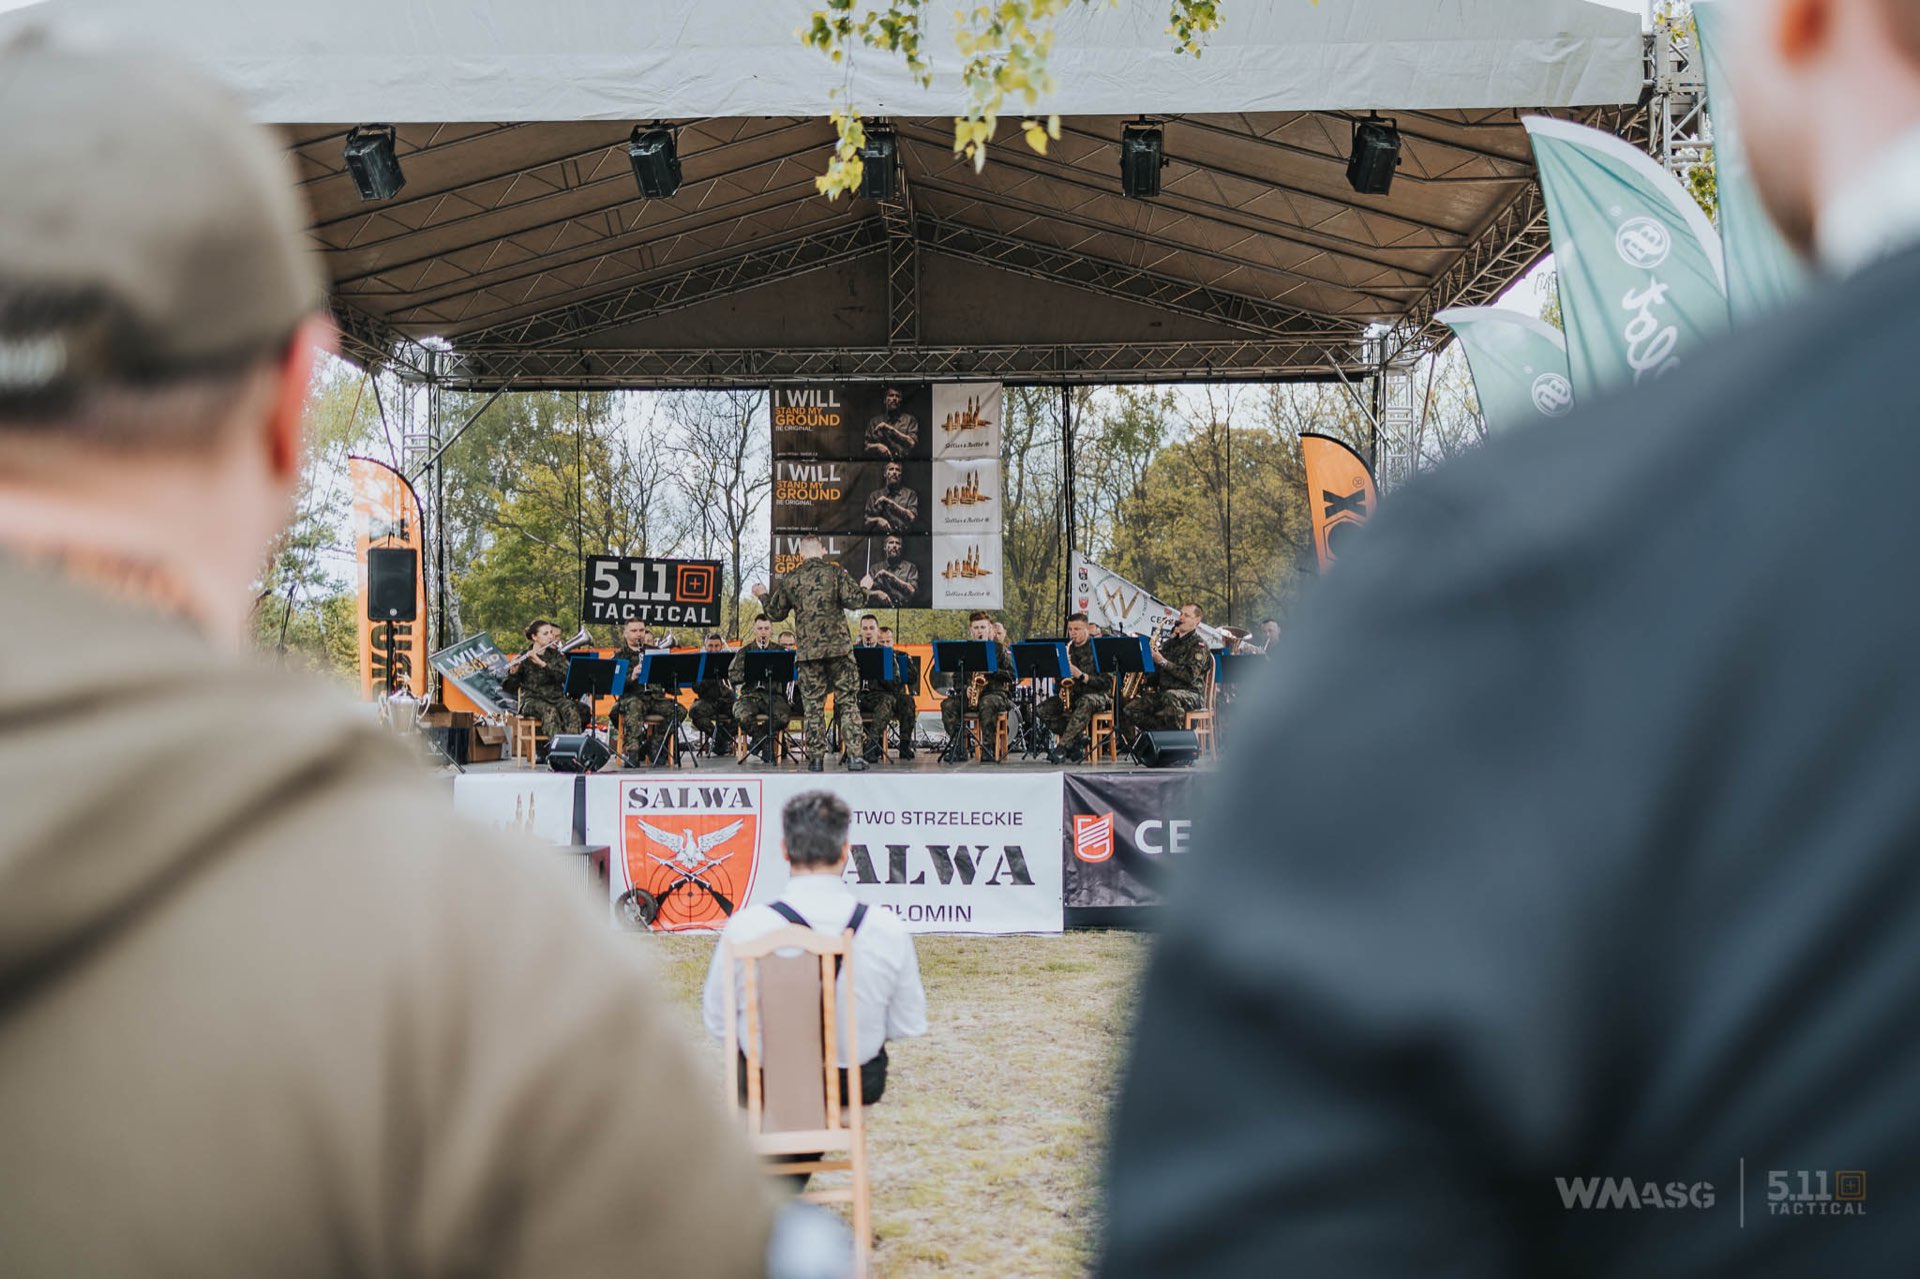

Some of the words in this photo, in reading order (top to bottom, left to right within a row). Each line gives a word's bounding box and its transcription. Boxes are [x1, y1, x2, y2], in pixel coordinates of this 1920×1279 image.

[774, 389, 780, 407] I
[786, 389, 841, 408] WILL
[775, 407, 806, 415] STAND
[808, 407, 823, 415] MY
[775, 414, 841, 426] GROUND
[776, 463, 782, 480] I
[788, 463, 841, 482] WILL
[776, 480, 808, 489] STAND
[809, 481, 824, 489] MY
[776, 488, 841, 501] GROUND
[775, 537, 781, 554] I
[787, 537, 841, 555] WL
[592, 560, 671, 601] 5.11
[592, 601, 712, 624] TACTICAL
[446, 642, 494, 668] WILL
[628, 786, 754, 809] SALWA
[850, 810, 896, 825] TWO
[901, 811, 1023, 826] STRZELECKIE
[1134, 819, 1192, 854] CE
[842, 843, 1036, 886] ALWA
